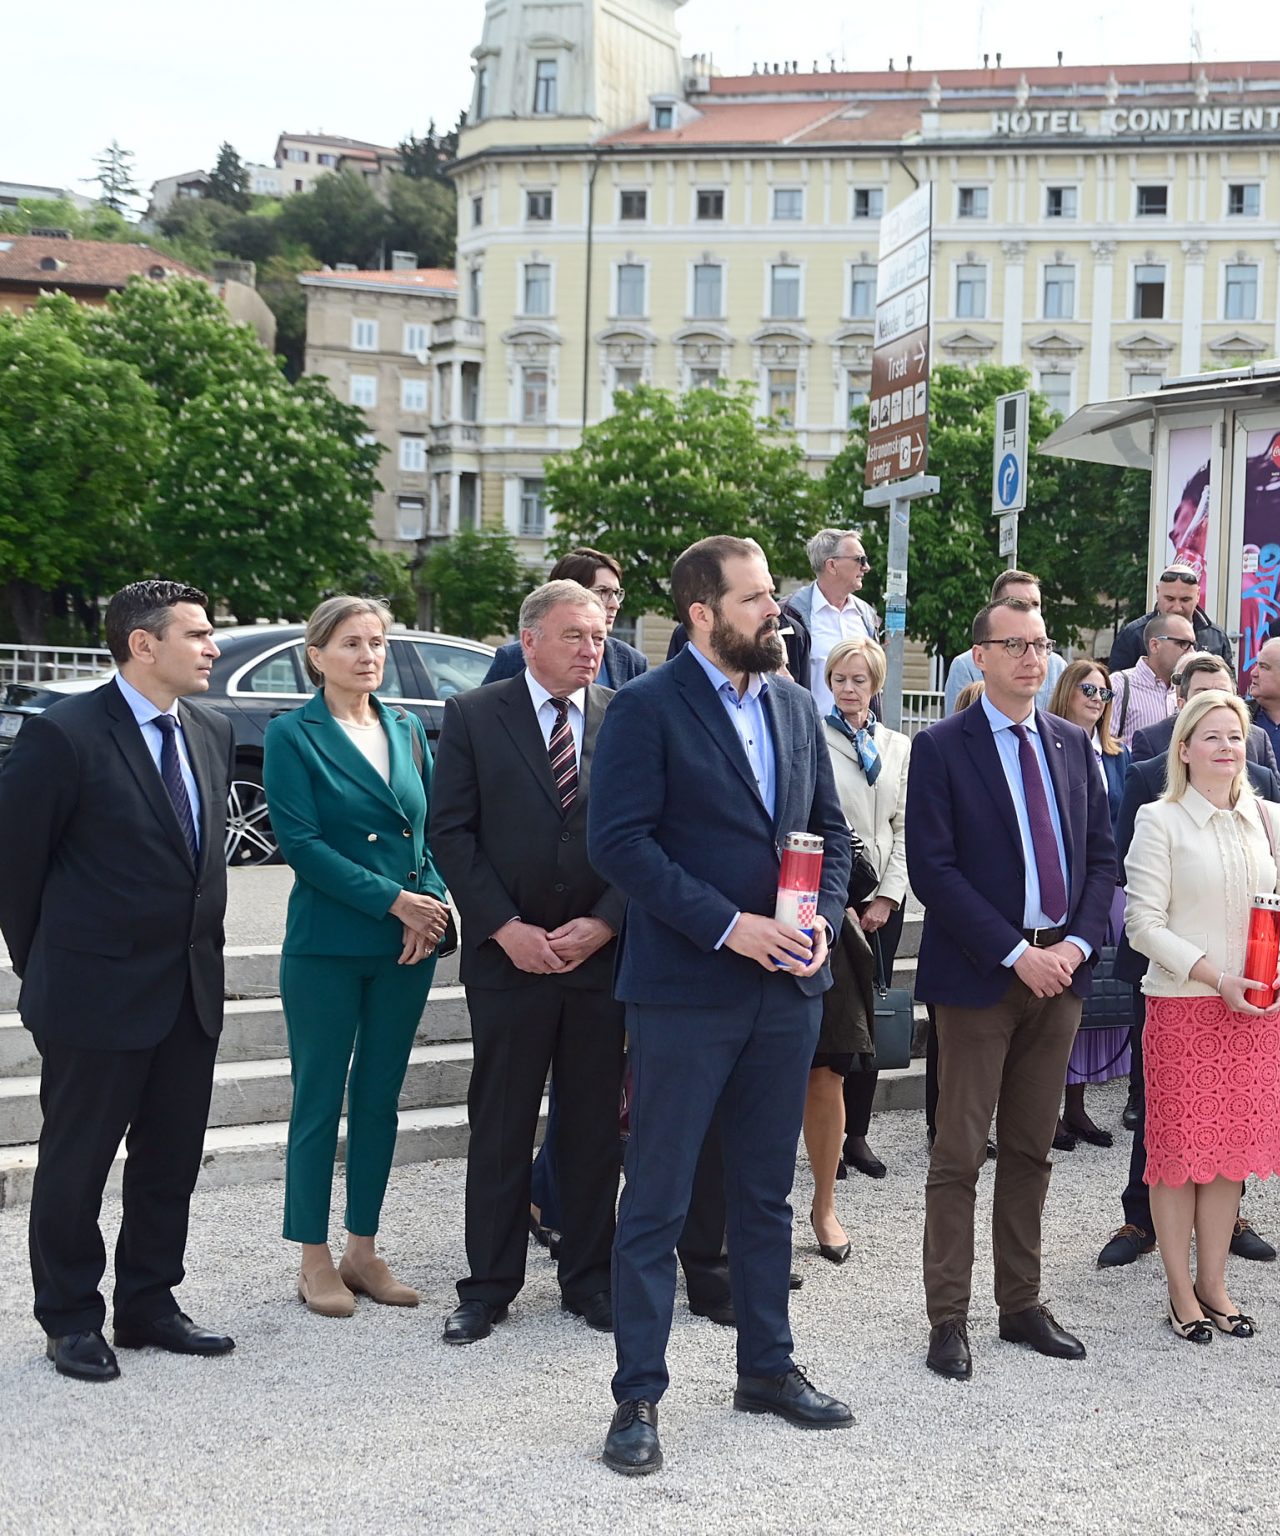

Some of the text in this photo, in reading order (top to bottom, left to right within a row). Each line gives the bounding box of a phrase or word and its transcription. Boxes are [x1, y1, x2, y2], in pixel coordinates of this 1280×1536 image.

[992, 110, 1085, 133] HOTEL
[888, 351, 908, 381] Trsat
[873, 460, 891, 480] centar
